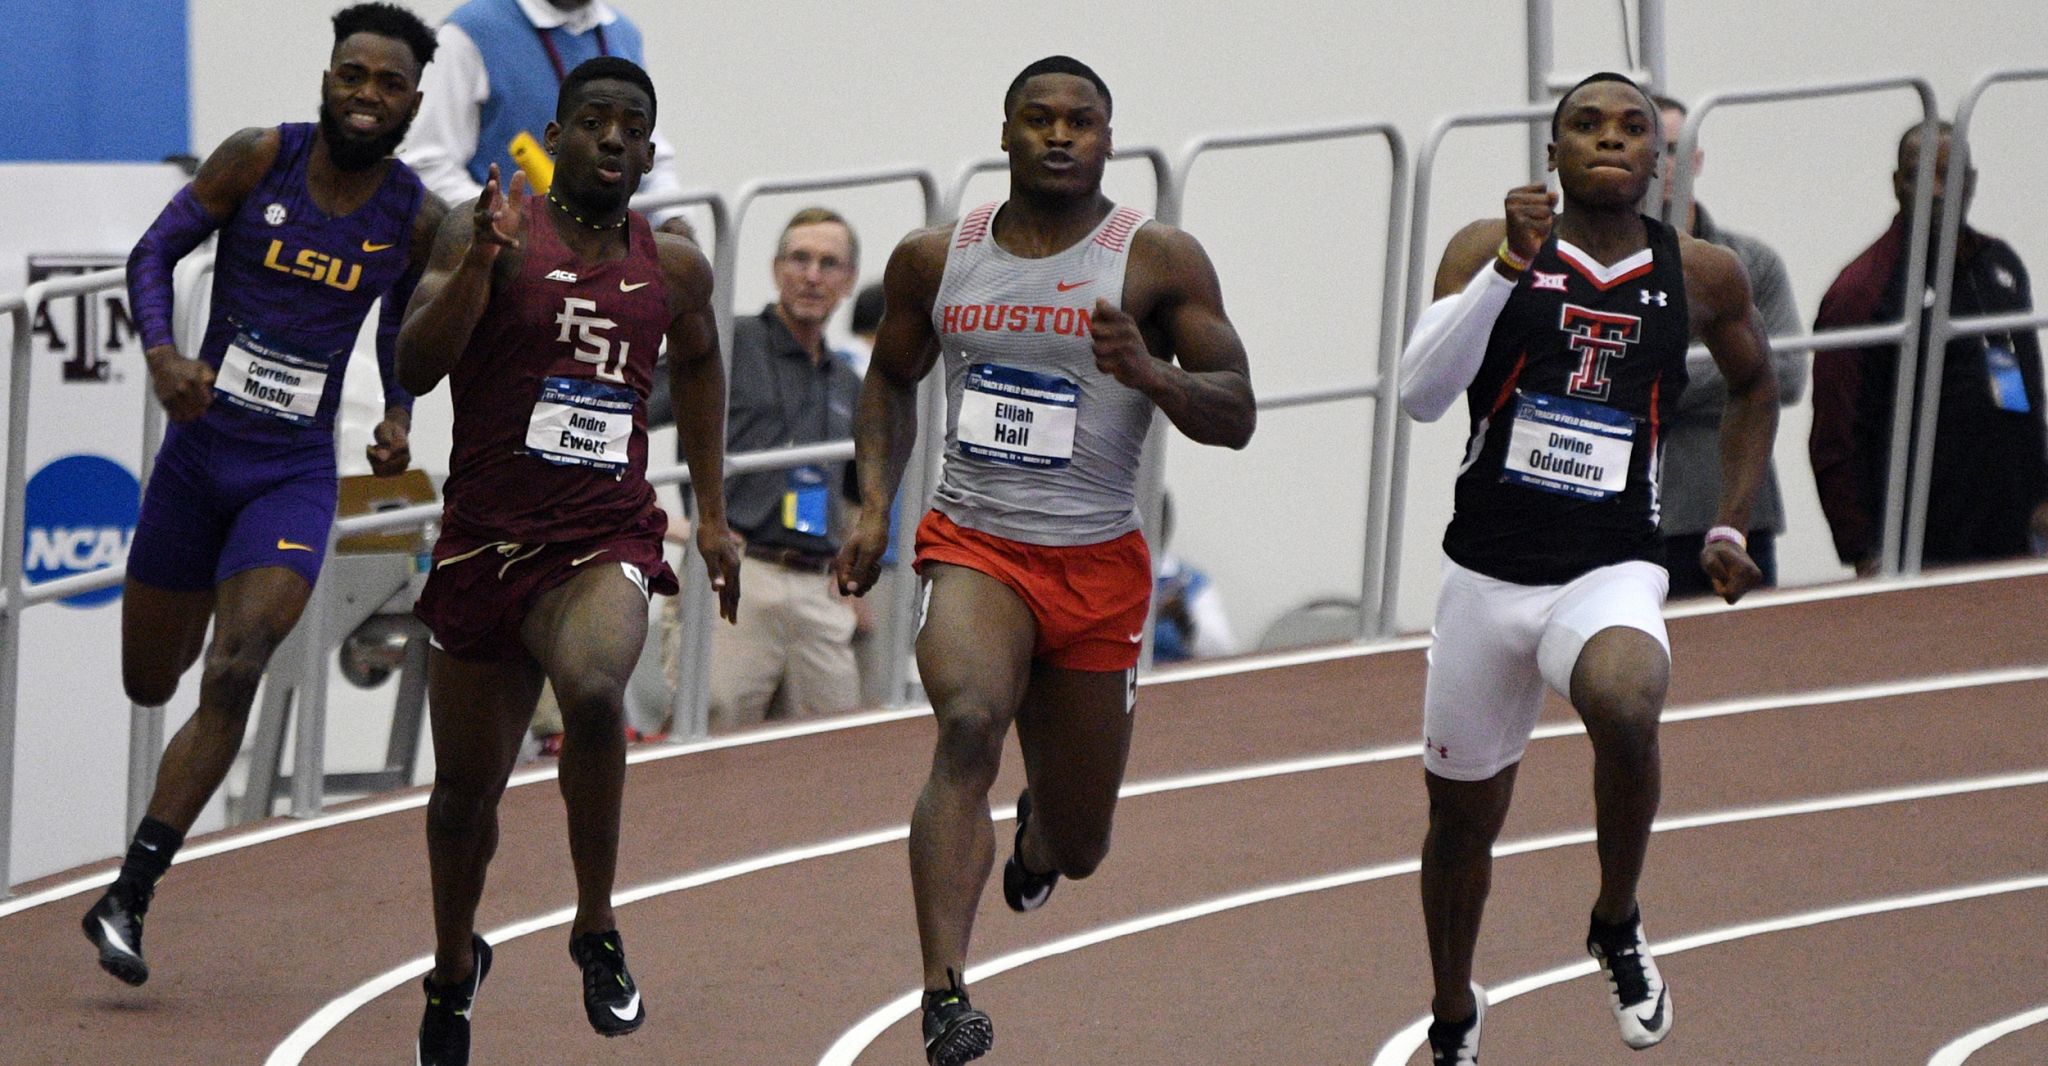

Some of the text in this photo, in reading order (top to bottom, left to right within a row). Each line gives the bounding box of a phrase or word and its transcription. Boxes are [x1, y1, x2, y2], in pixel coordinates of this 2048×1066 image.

[264, 239, 362, 292] LSU
[544, 269, 578, 283] ACC
[943, 304, 1093, 337] HOUSTON
[555, 297, 630, 384] FSU
[248, 361, 302, 387] Correion
[243, 378, 295, 408] Mosby
[569, 413, 607, 433] Andre
[995, 402, 1034, 424] Elijah
[559, 430, 608, 455] Ewers
[994, 423, 1029, 447] Hall
[1548, 432, 1593, 455] Divine
[1529, 449, 1604, 481] Oduduru
[26, 528, 137, 571] NCA
